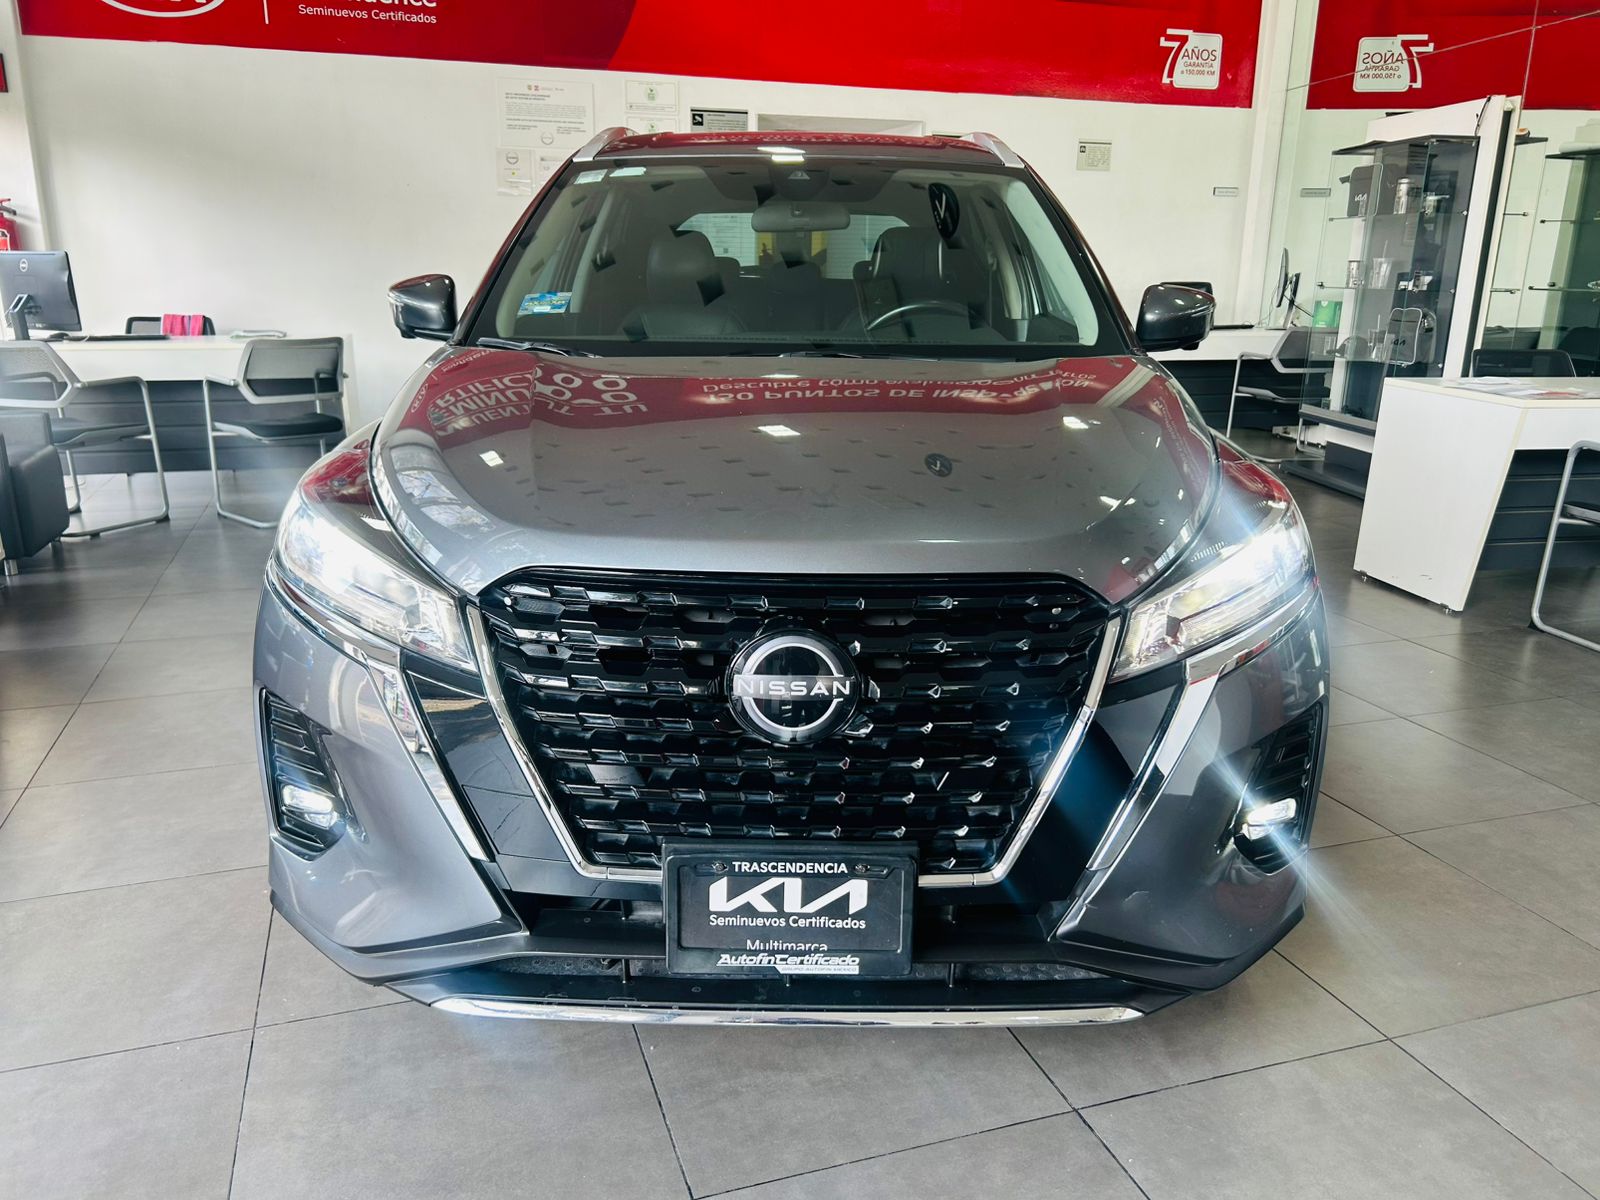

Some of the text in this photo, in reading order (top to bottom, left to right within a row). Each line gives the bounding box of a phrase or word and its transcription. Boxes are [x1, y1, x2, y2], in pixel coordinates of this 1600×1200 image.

[298, 4, 437, 24] Seminuevos Certificados
[1181, 46, 1217, 62] AÑOS
[736, 680, 850, 696] NISSAN
[732, 861, 848, 874] TRASCENDENCIA
[709, 876, 868, 914] KIA
[709, 914, 866, 929] Seminuevos Certificados
[746, 939, 828, 951] Multimarca
